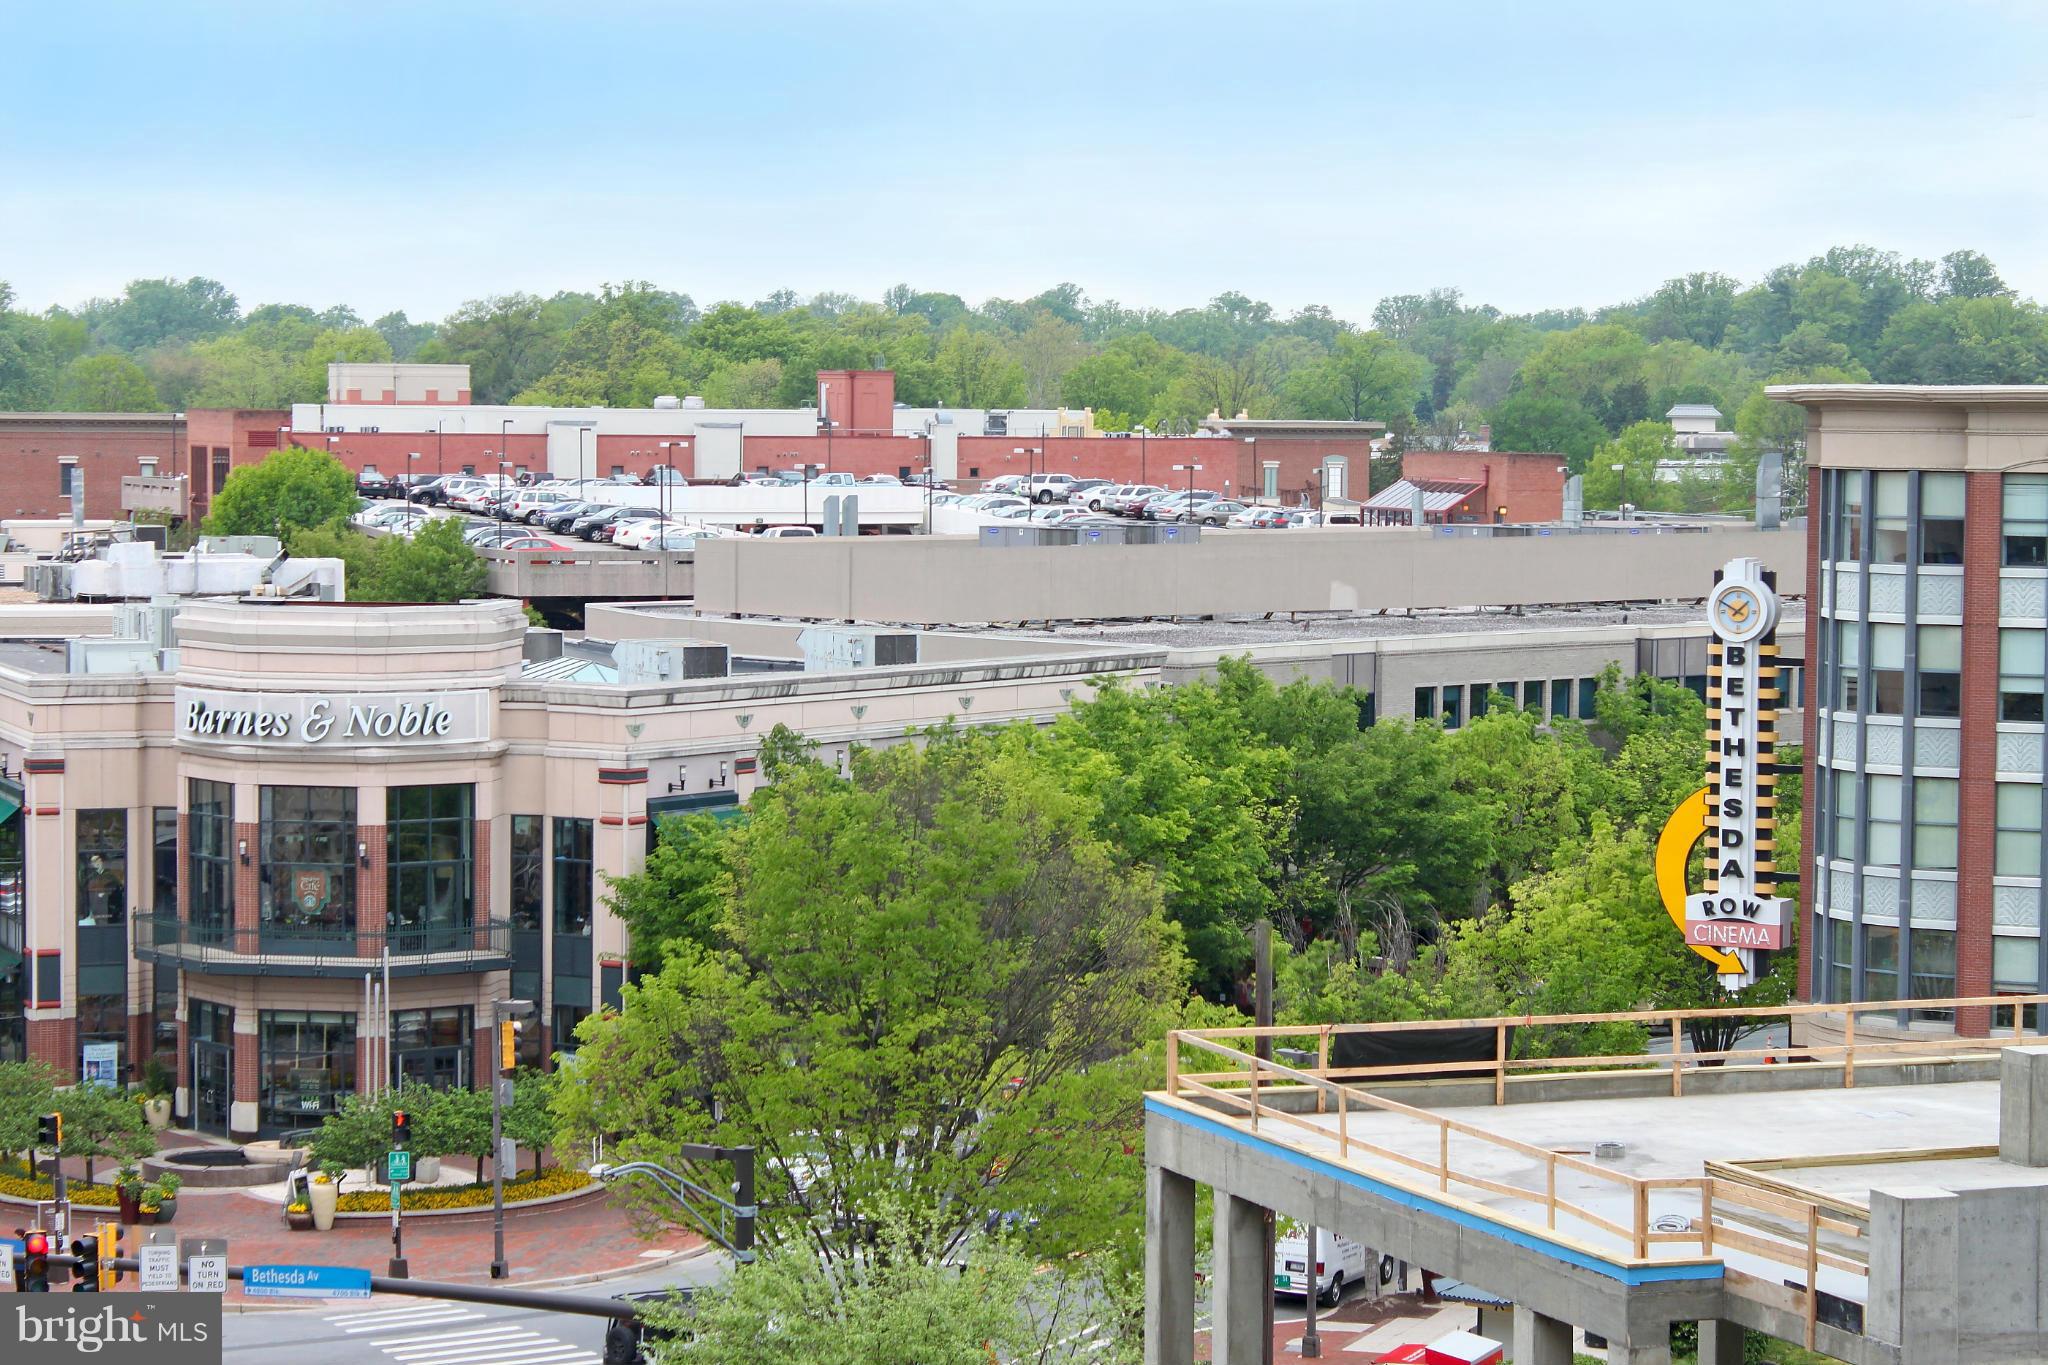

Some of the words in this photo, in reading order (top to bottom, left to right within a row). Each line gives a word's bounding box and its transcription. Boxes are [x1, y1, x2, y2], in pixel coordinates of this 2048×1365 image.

[184, 700, 291, 737] Barnes
[300, 699, 336, 743] &
[342, 702, 454, 737] Noble
[1720, 646, 1746, 879] BETHESDA
[1702, 897, 1761, 918] ROW
[1693, 924, 1771, 945] CINEMA
[149, 1264, 169, 1272] MUST
[201, 1260, 215, 1268] NO
[197, 1271, 219, 1279] TURN
[252, 1268, 305, 1284] Bethesda
[307, 1270, 319, 1281] Av
[192, 1281, 204, 1289] ON
[207, 1280, 224, 1289] RED
